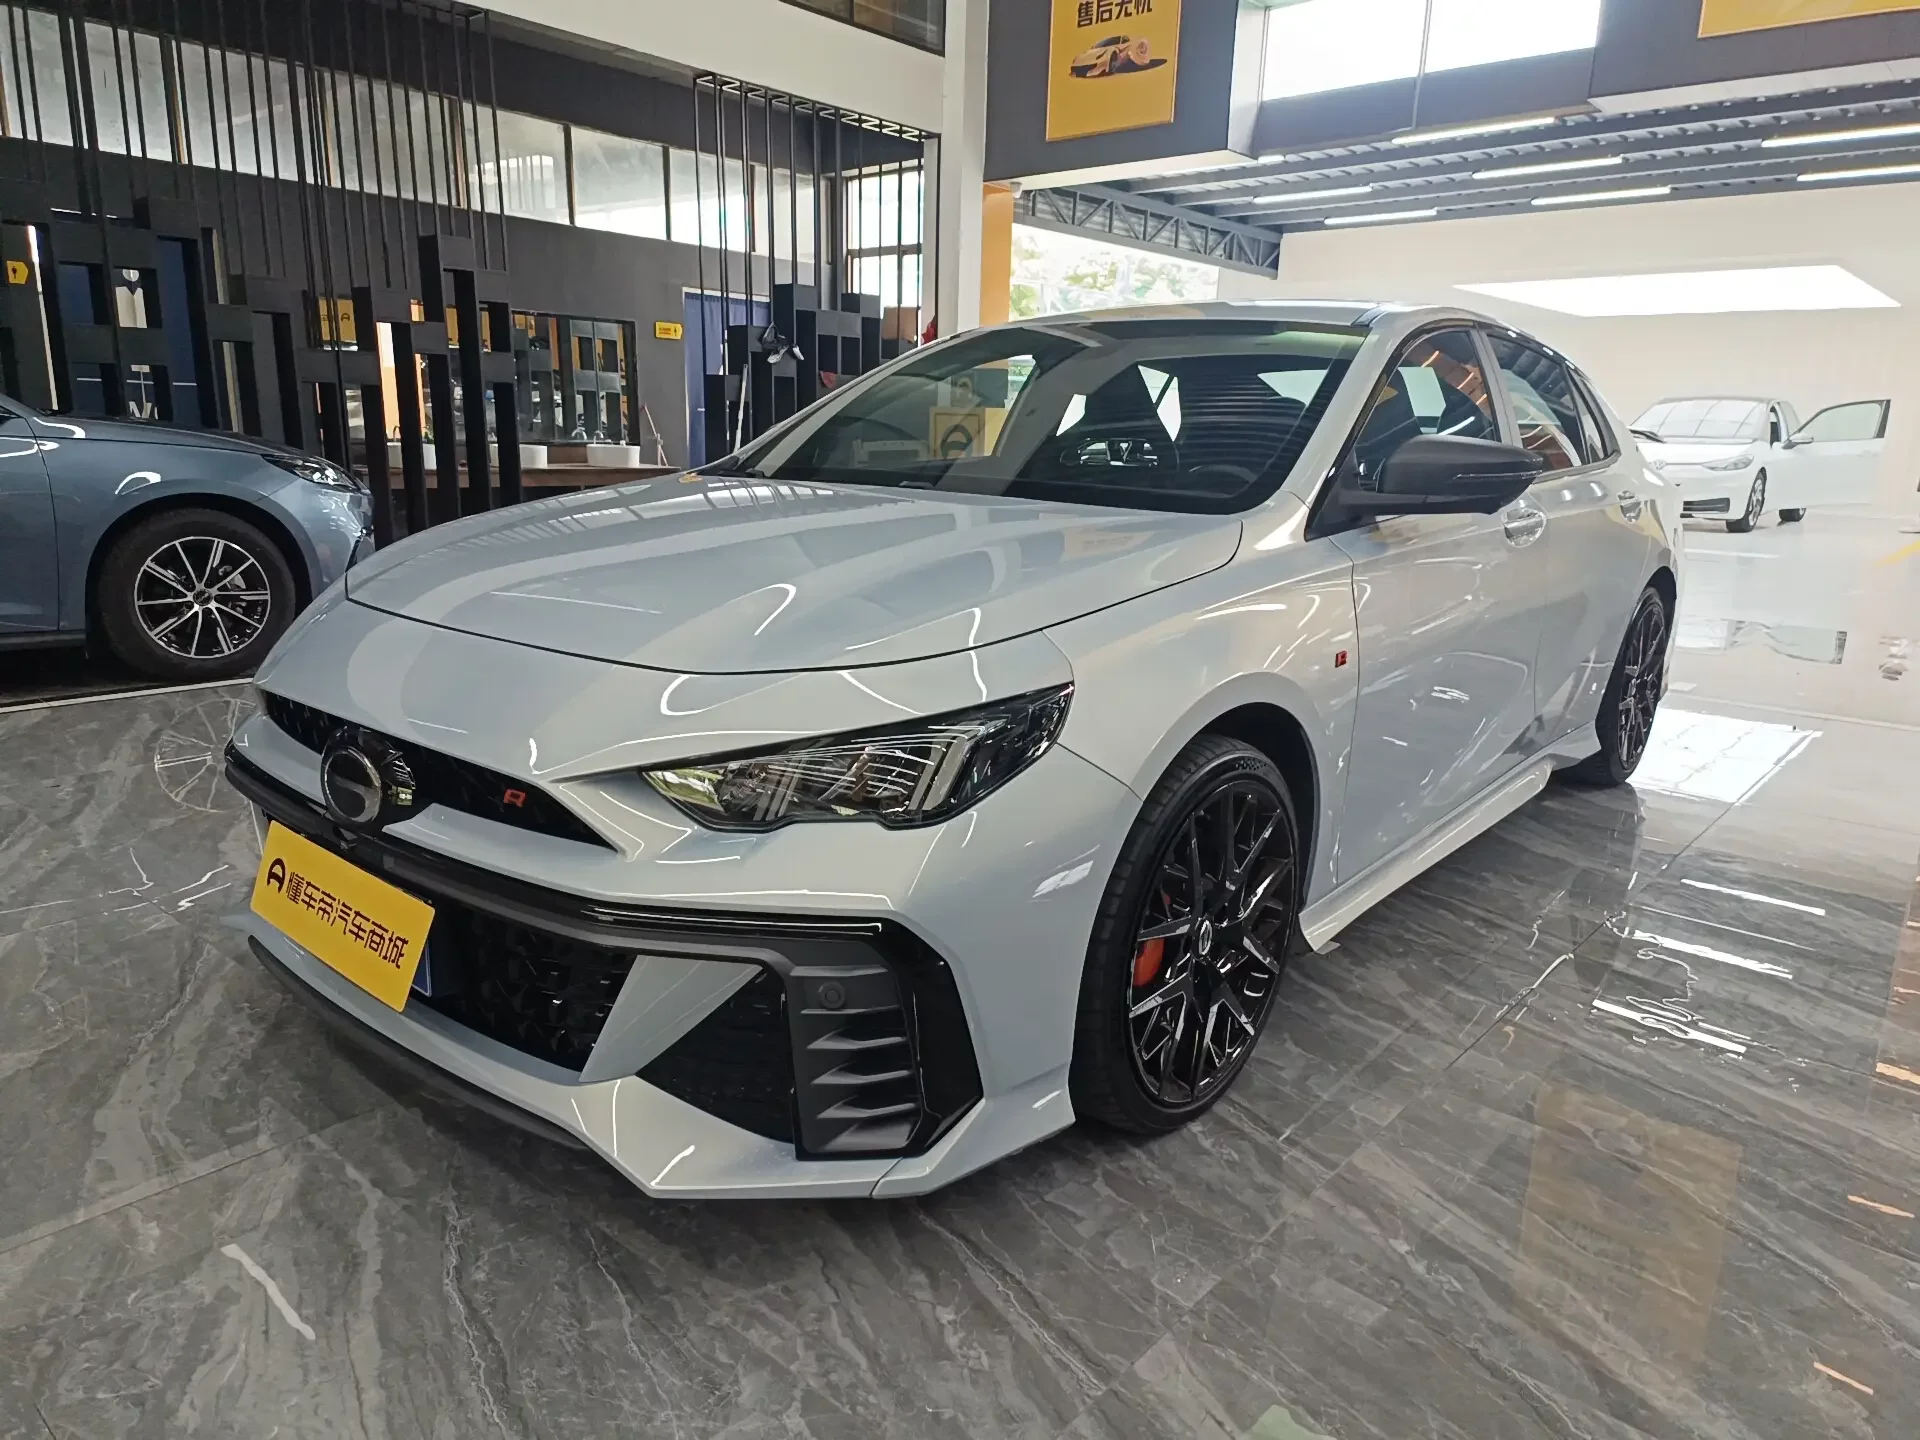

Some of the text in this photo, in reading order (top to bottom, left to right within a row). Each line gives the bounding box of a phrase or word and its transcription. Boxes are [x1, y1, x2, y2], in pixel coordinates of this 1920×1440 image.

[286, 871, 409, 970] 懂车帝汽车商城
